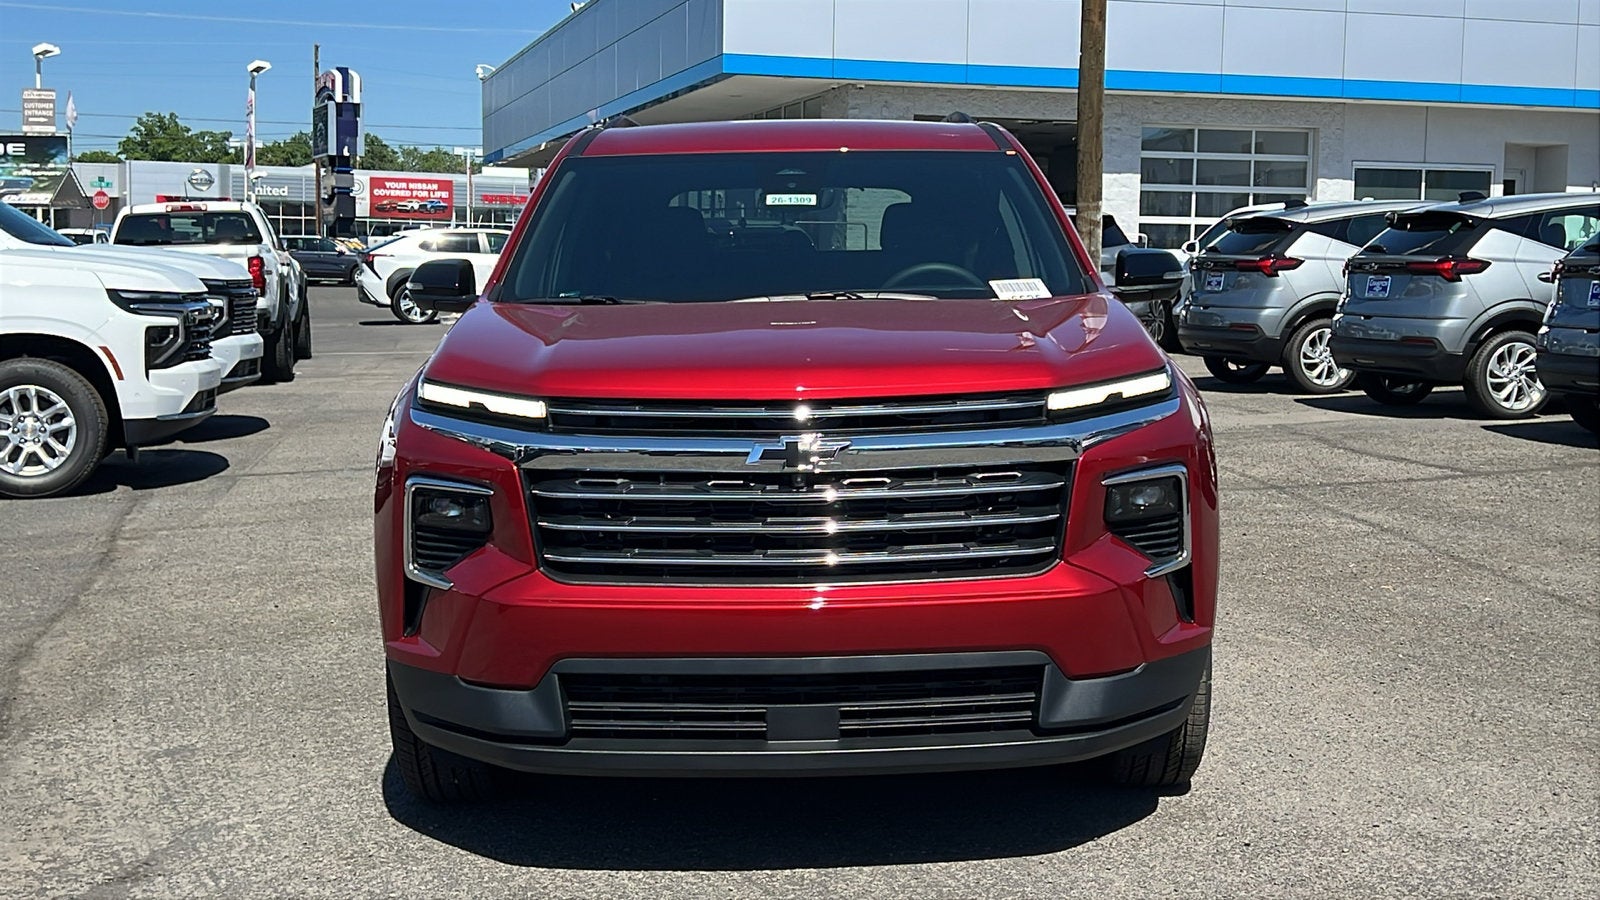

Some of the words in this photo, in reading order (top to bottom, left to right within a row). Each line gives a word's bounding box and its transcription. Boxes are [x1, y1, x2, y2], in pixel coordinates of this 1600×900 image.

[24, 109, 54, 117] ENTRANCE
[385, 181, 407, 189] YOUR
[373, 189, 412, 197] COVERED
[94, 195, 109, 203] STOP
